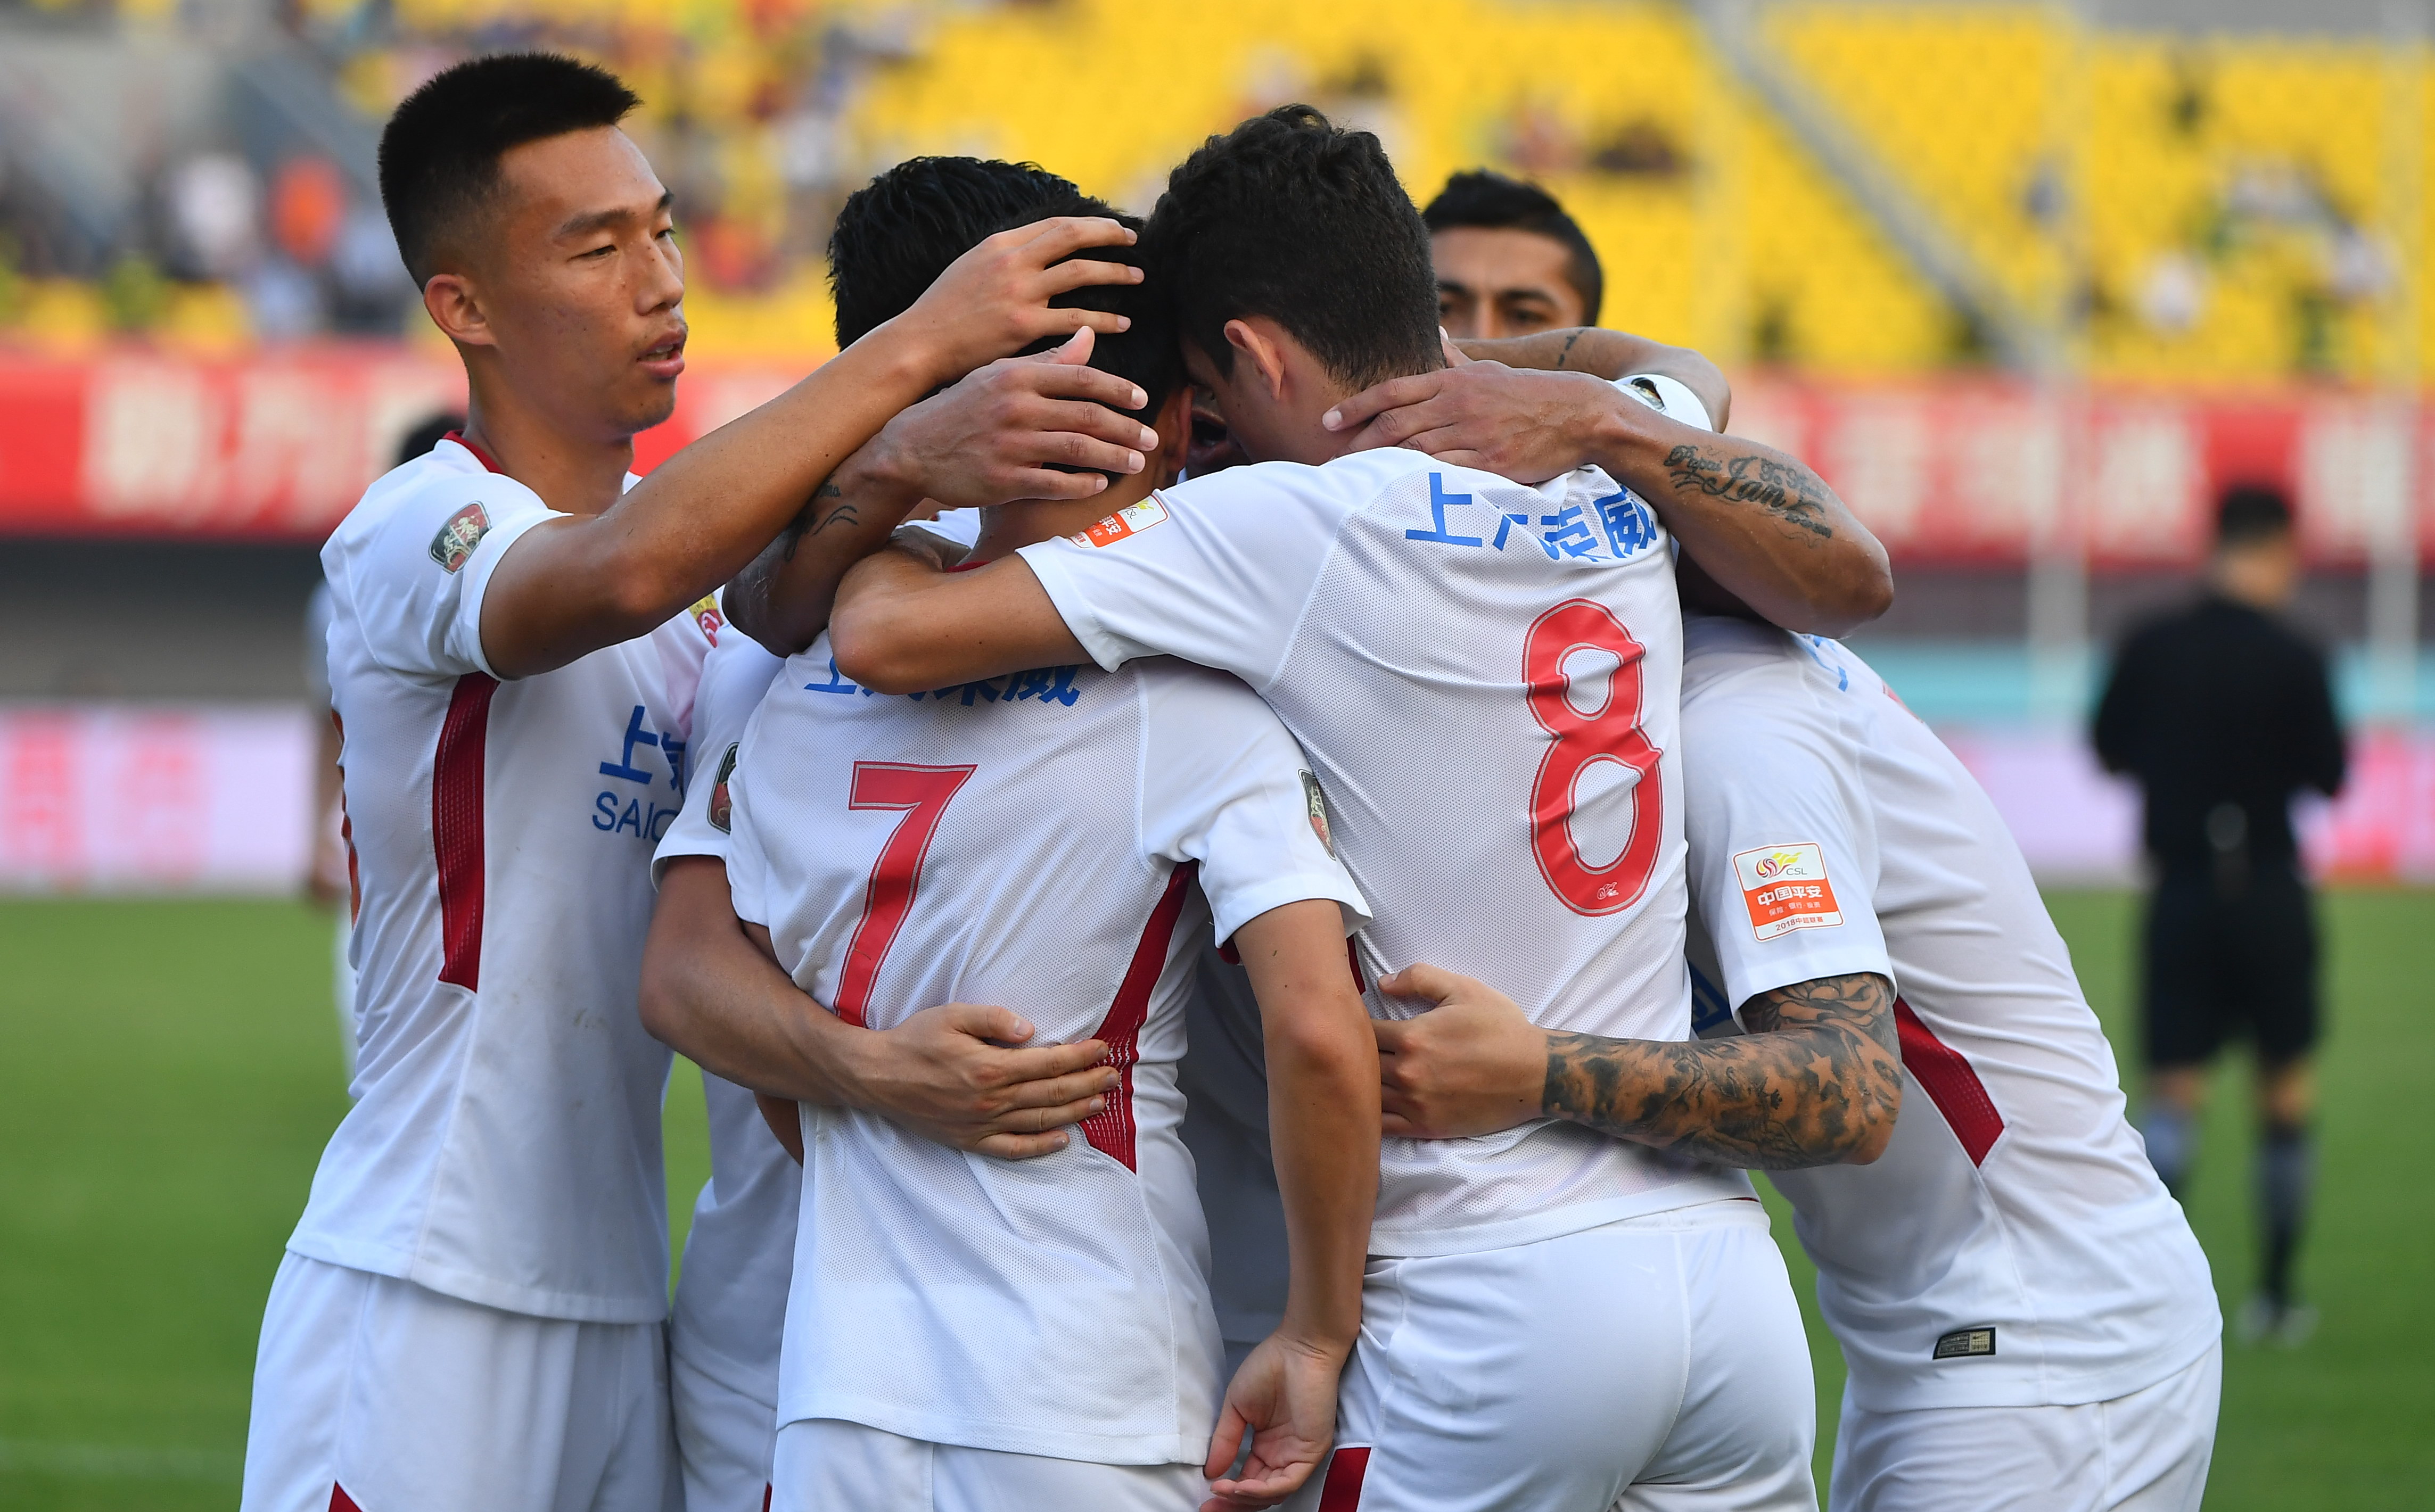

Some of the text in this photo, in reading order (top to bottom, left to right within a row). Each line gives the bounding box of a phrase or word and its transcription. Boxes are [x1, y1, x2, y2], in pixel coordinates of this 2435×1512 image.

[1521, 598, 1664, 917] 8
[833, 761, 978, 1028] 7
[1757, 885, 1823, 906] 中国平安
